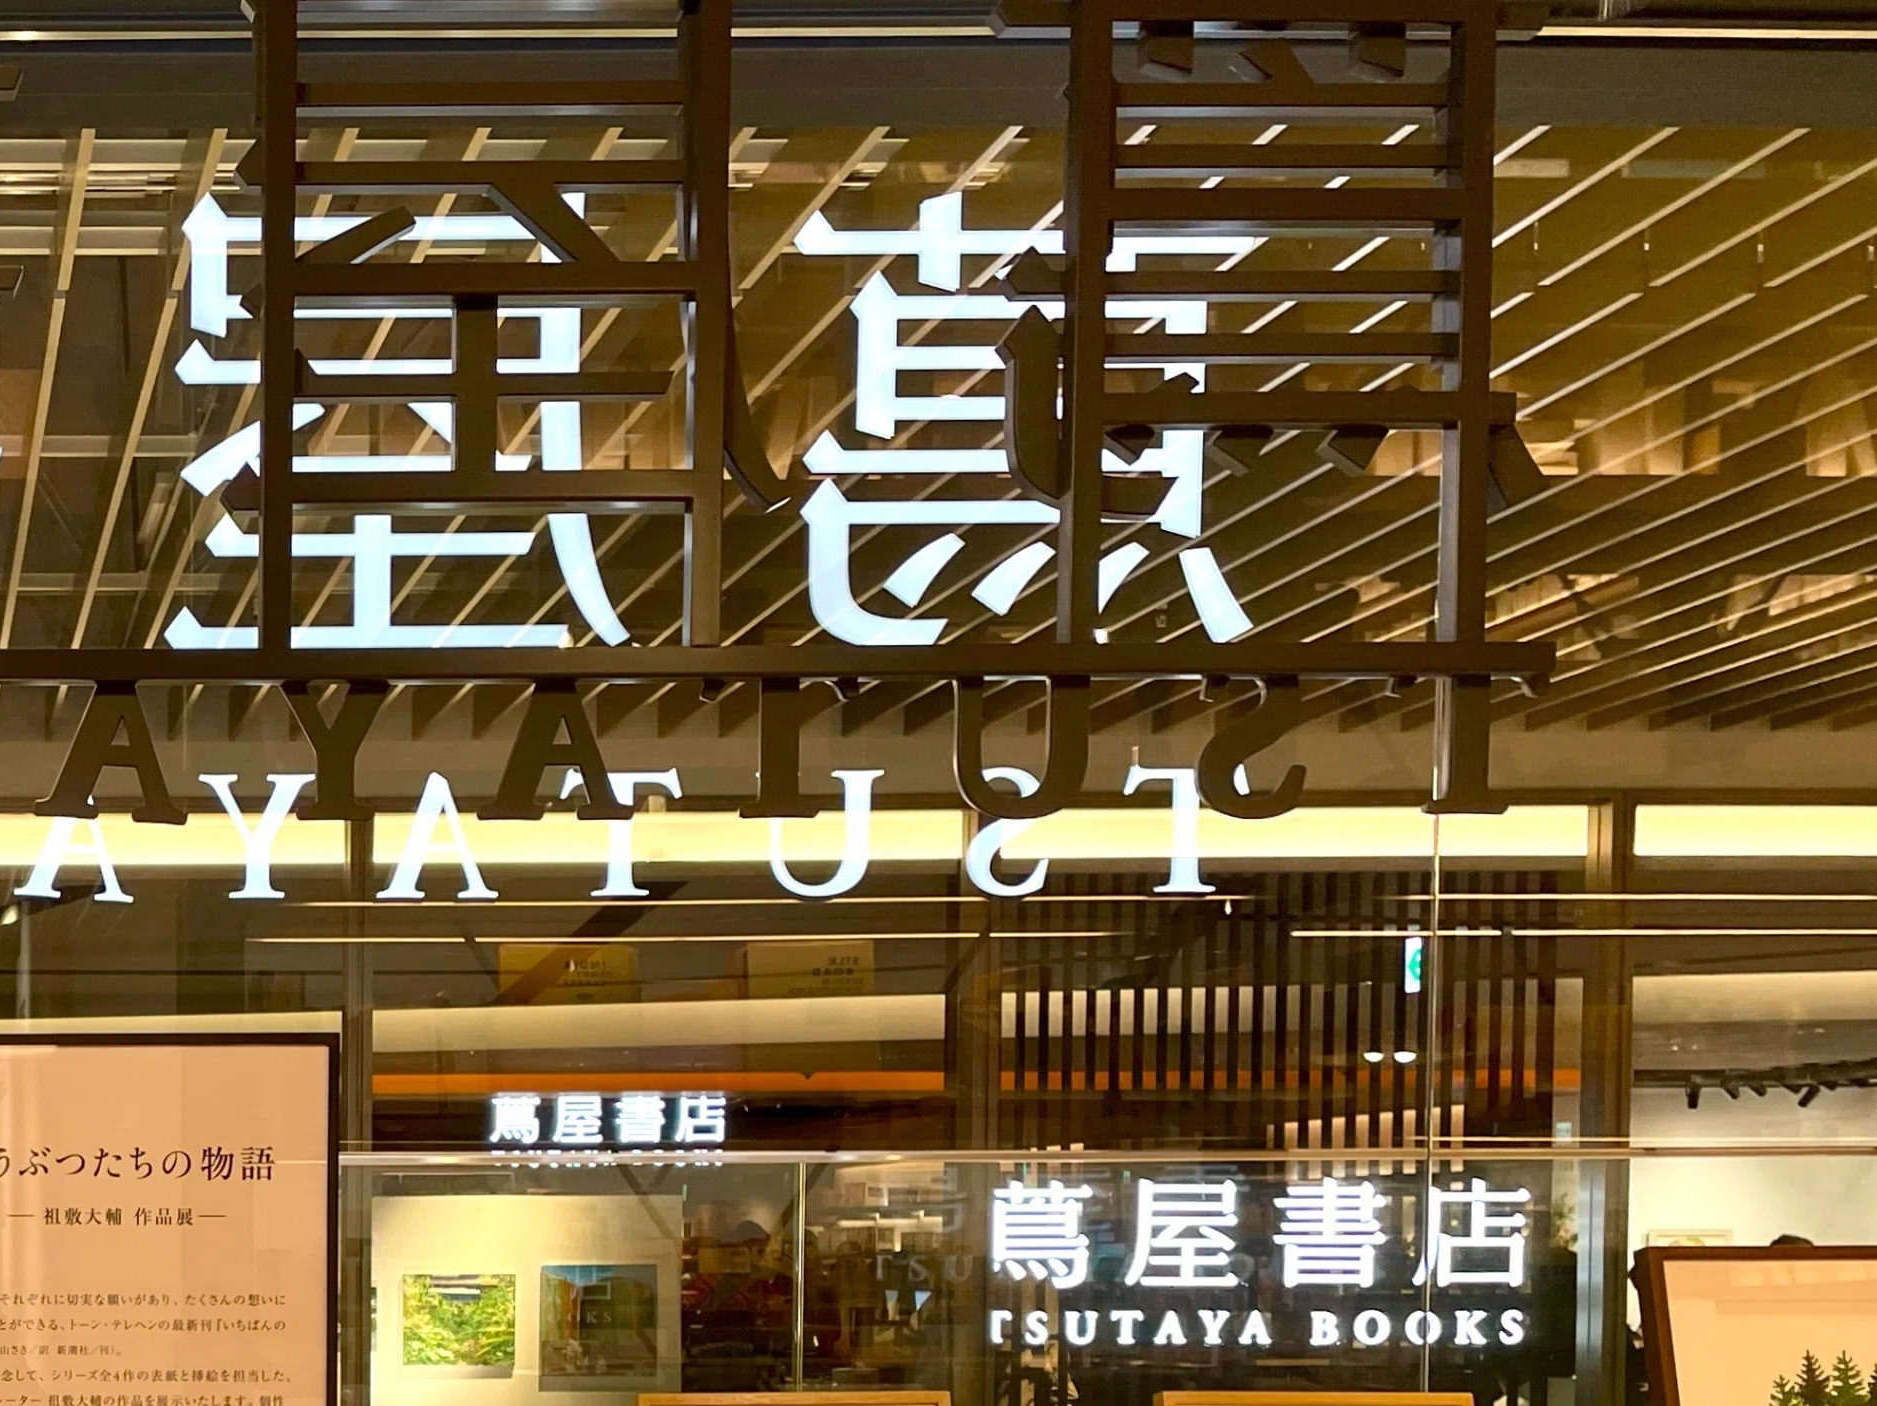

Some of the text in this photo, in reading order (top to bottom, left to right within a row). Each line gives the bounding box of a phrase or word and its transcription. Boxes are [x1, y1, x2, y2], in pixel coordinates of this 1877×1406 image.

[489, 1093, 726, 1144] 蔦屋書店
[43, 1206, 194, 1227] 祖敷大輔 作品展
[992, 1177, 1532, 1290] 蔦屋書店
[990, 1310, 1525, 1346] TSUTAYA BOOKS
